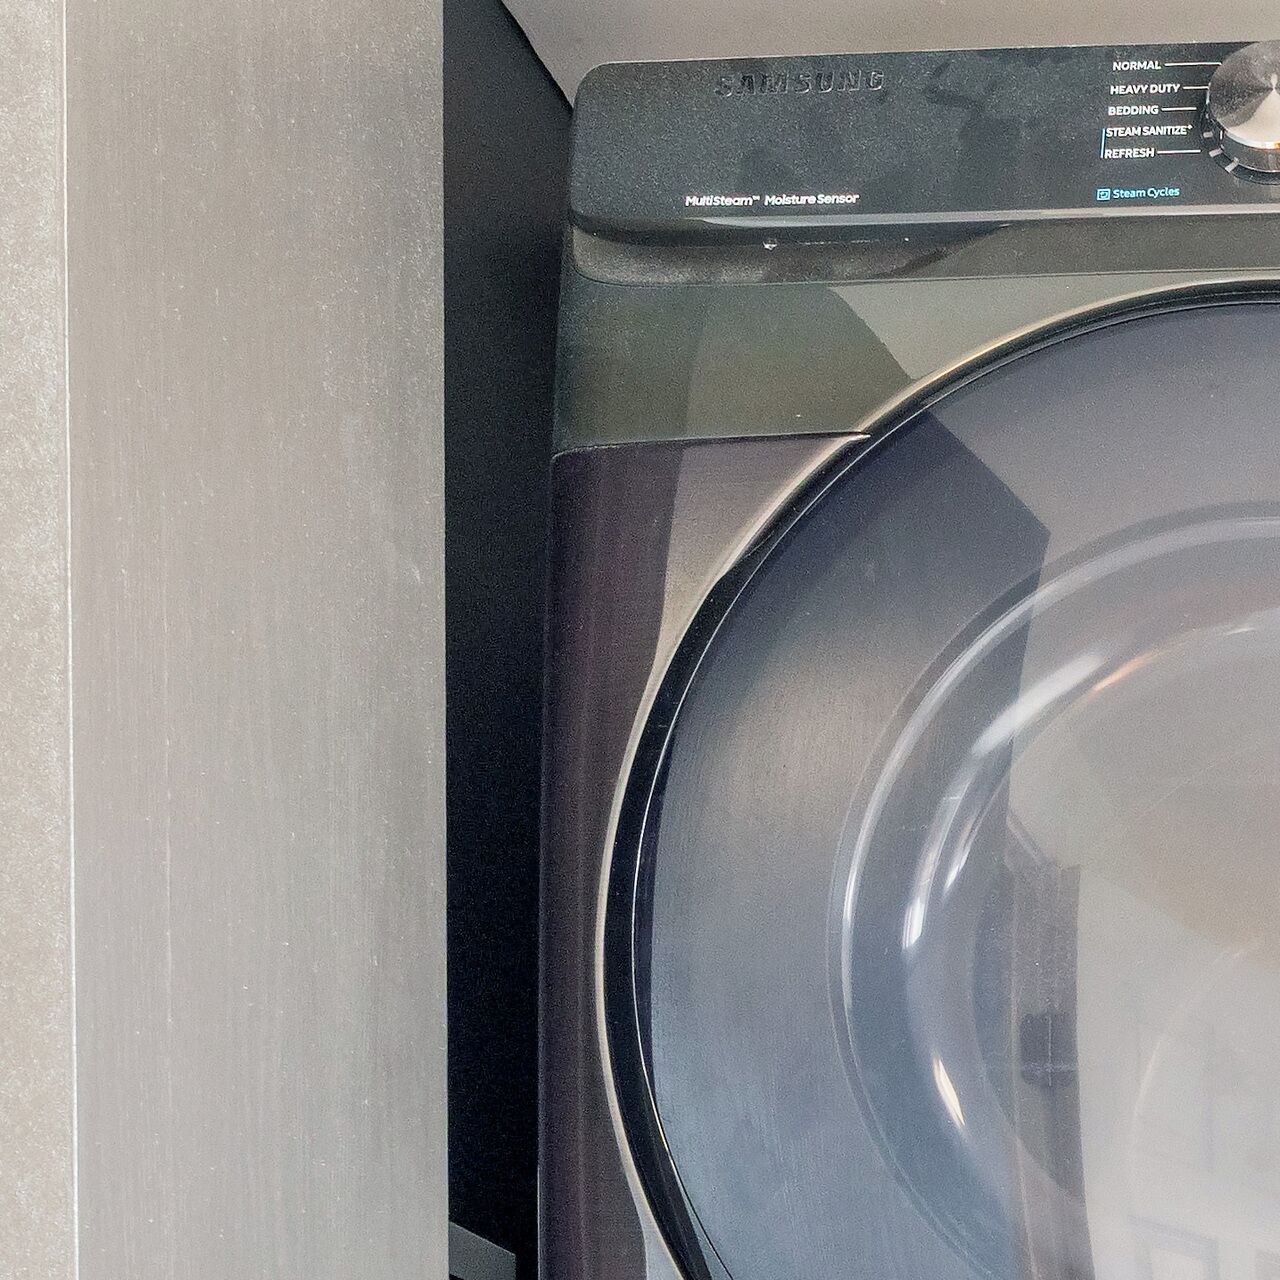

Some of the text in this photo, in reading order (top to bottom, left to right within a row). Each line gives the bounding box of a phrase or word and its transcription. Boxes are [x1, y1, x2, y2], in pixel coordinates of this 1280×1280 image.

[1113, 61, 1161, 71] NORMAL
[714, 69, 884, 97] SAMSUNG
[1110, 84, 1180, 95] HEAVY DUTY
[1108, 105, 1159, 116] BEDDING
[1106, 127, 1141, 137] STEAM
[1104, 148, 1155, 159] REFRESH
[1113, 187, 1180, 199] Steam Cycles
[764, 194, 816, 206] Moisture
[817, 194, 860, 204] Sensor
